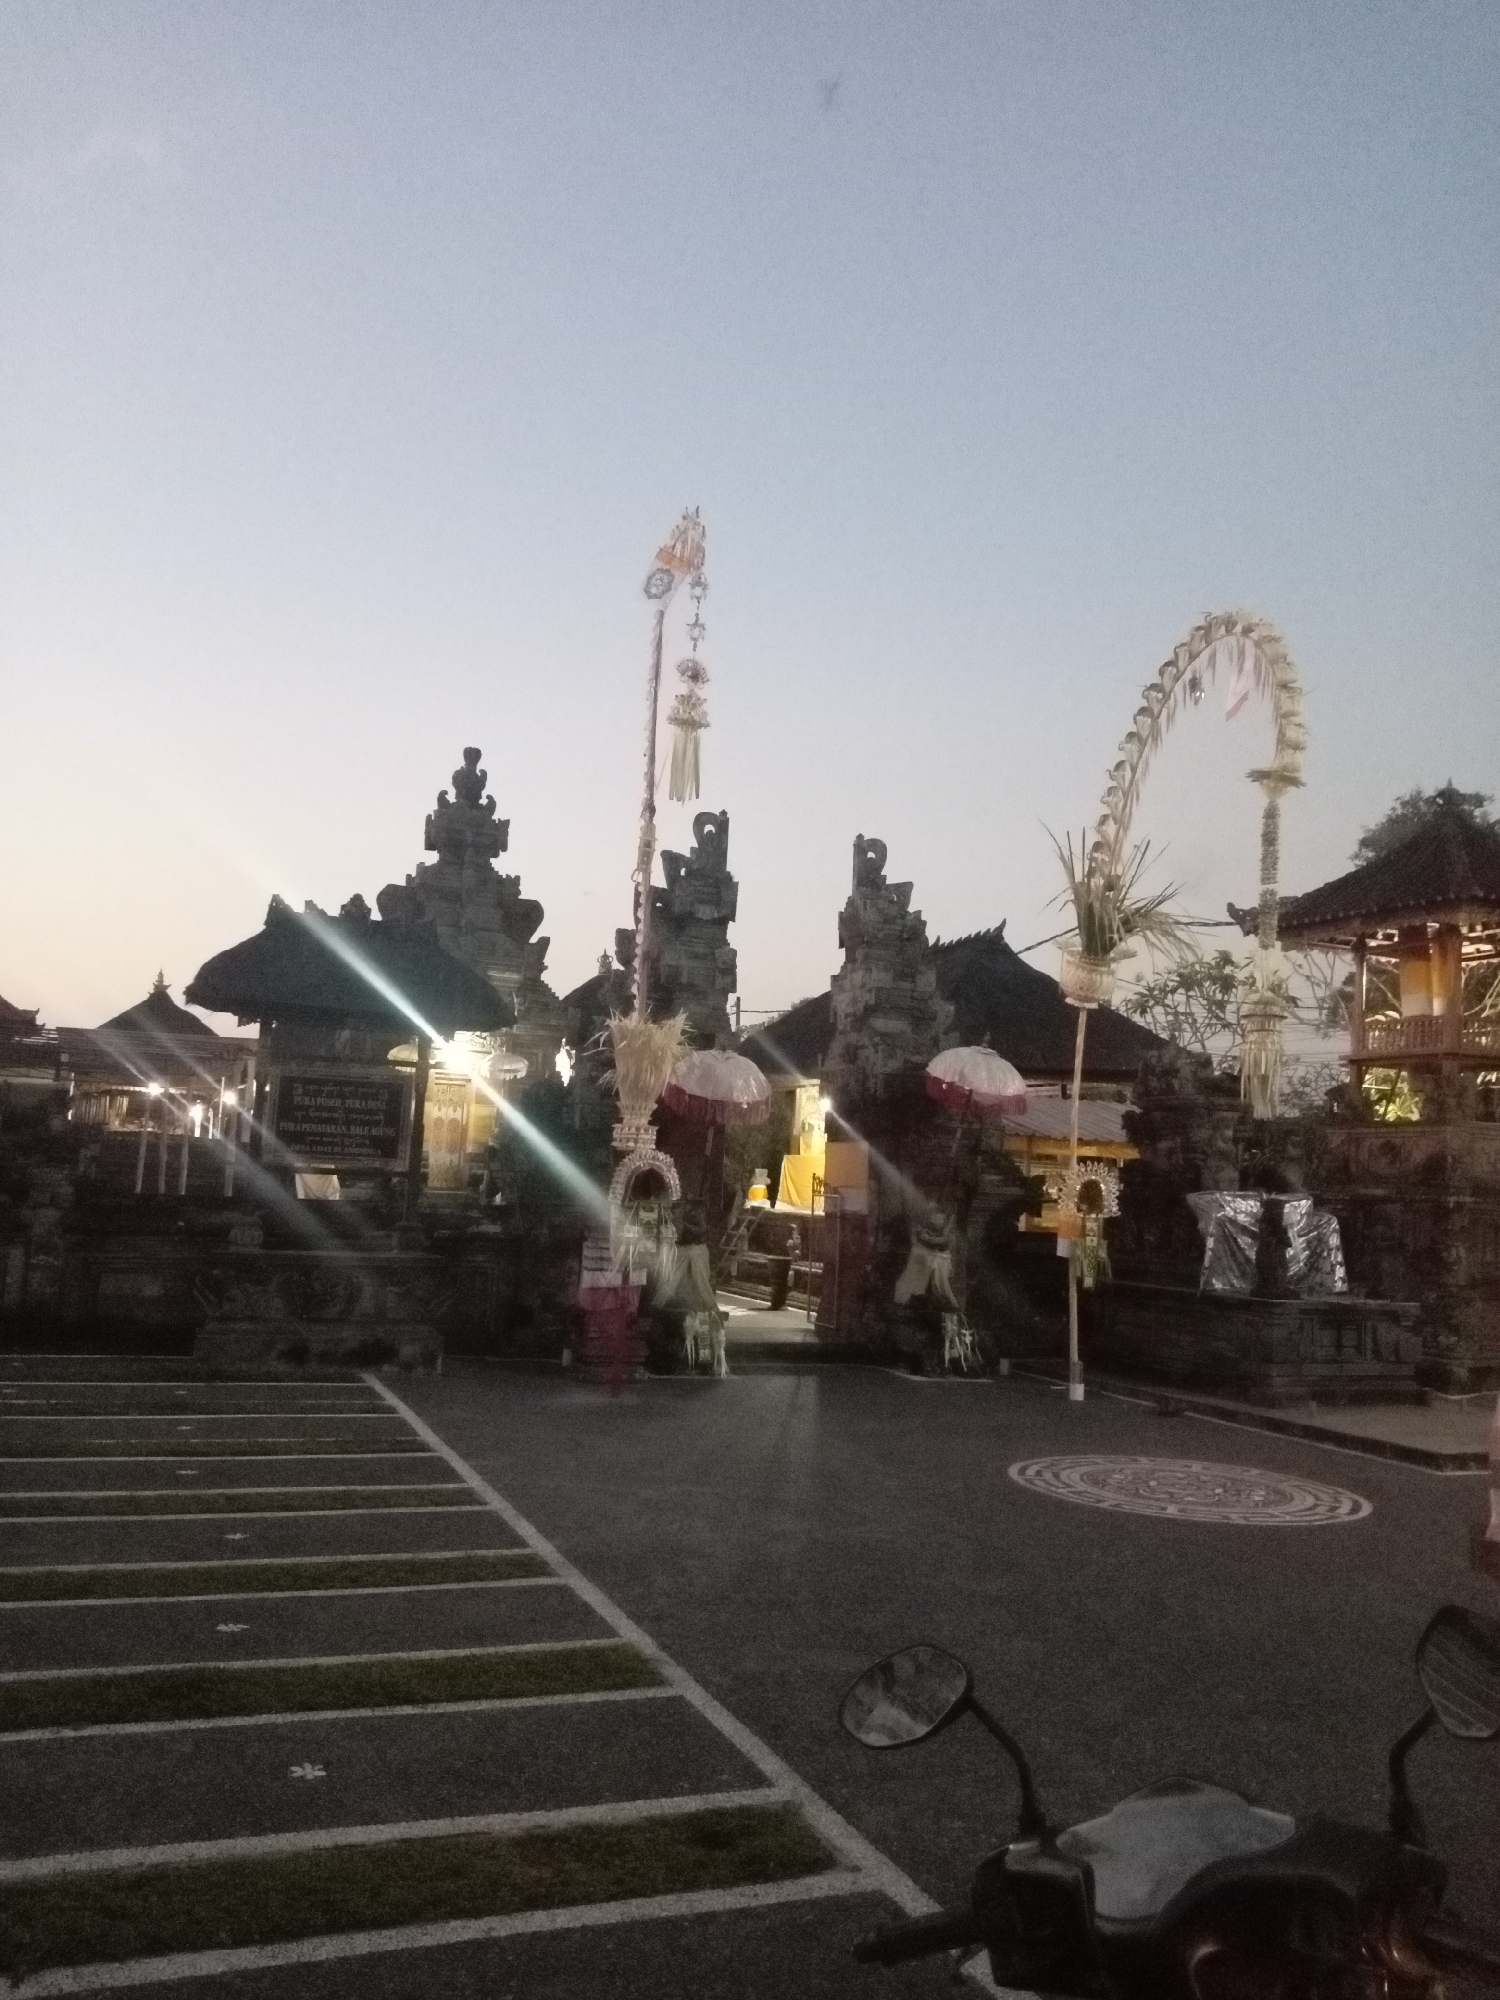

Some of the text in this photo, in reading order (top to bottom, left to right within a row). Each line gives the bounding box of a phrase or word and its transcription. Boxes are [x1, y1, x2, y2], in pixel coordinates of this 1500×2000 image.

[293, 1096, 315, 1106] PURA
[345, 1098, 367, 1108] PURA
[367, 1099, 387, 1110] DESA
[279, 1122, 300, 1132] PURA
[370, 1126, 396, 1137] AGUNG
